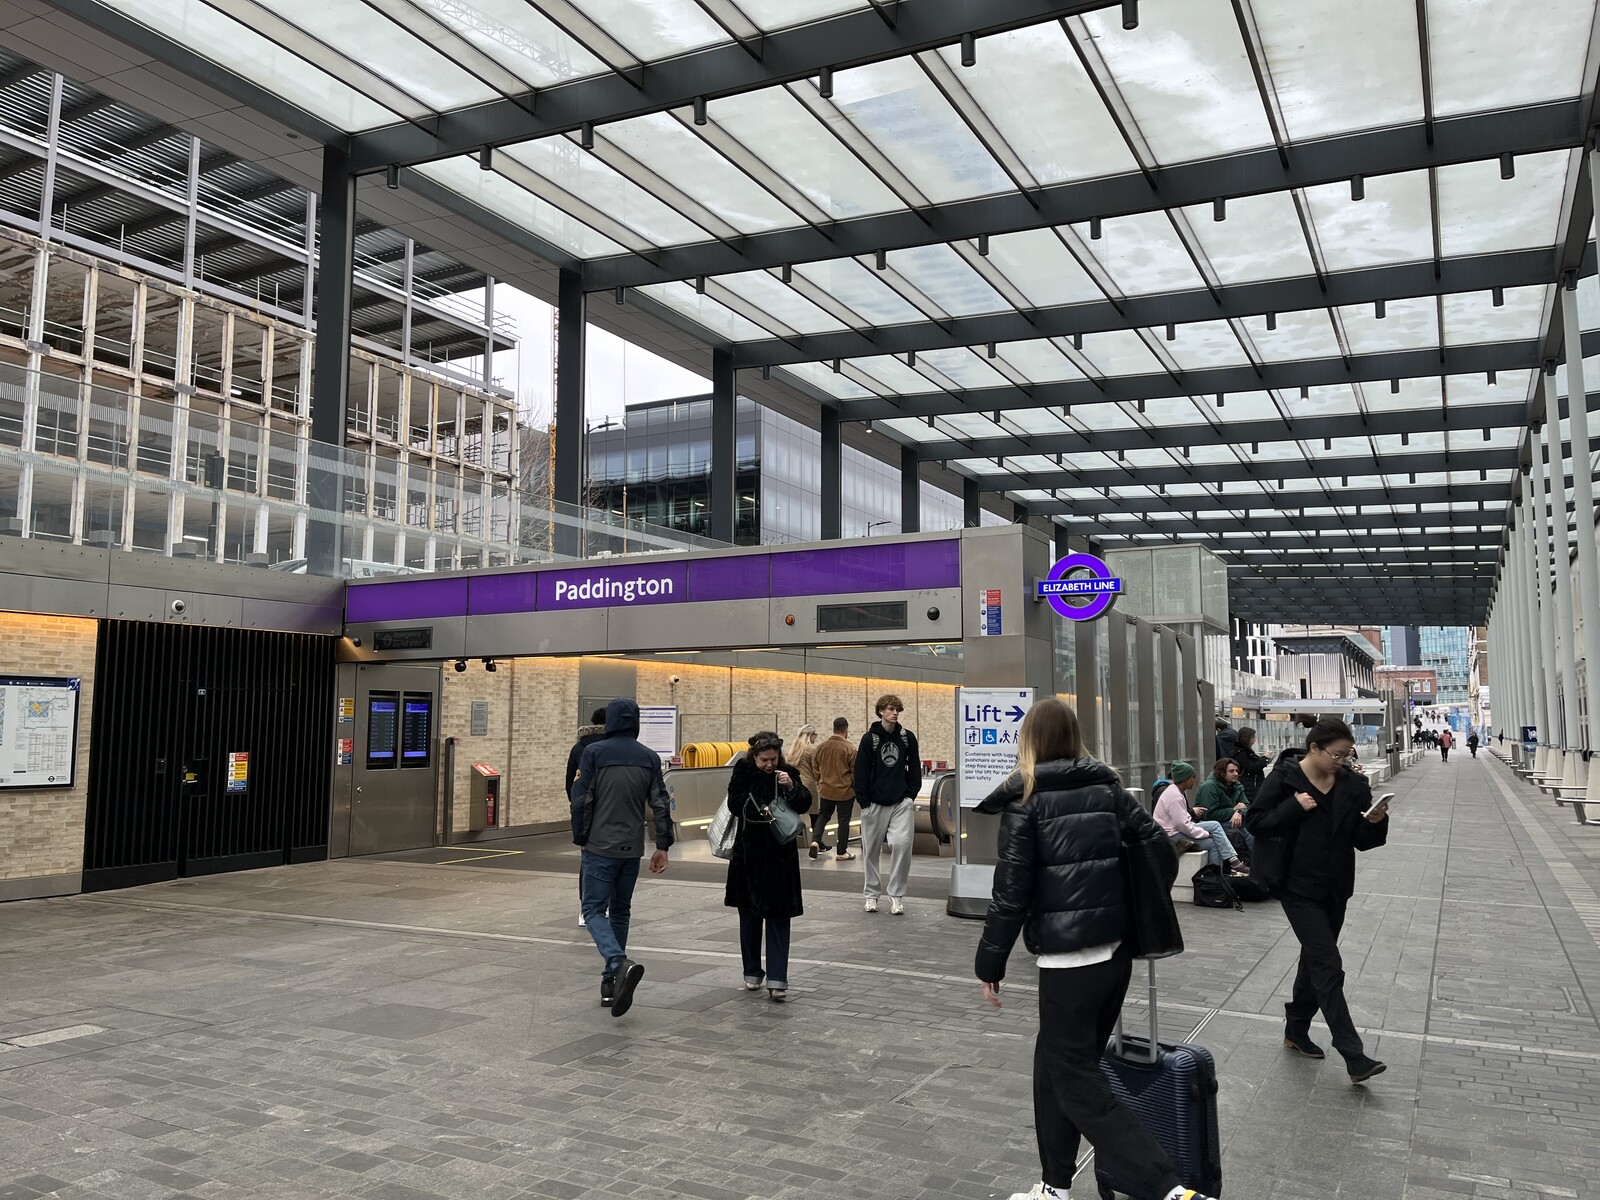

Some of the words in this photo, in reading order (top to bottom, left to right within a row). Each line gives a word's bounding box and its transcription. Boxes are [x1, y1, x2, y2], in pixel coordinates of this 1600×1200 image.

[555, 577, 673, 602] Paddington
[1043, 582, 1092, 592] ELIZABETH
[1094, 581, 1115, 590] LINE
[965, 704, 1002, 722] Lift
